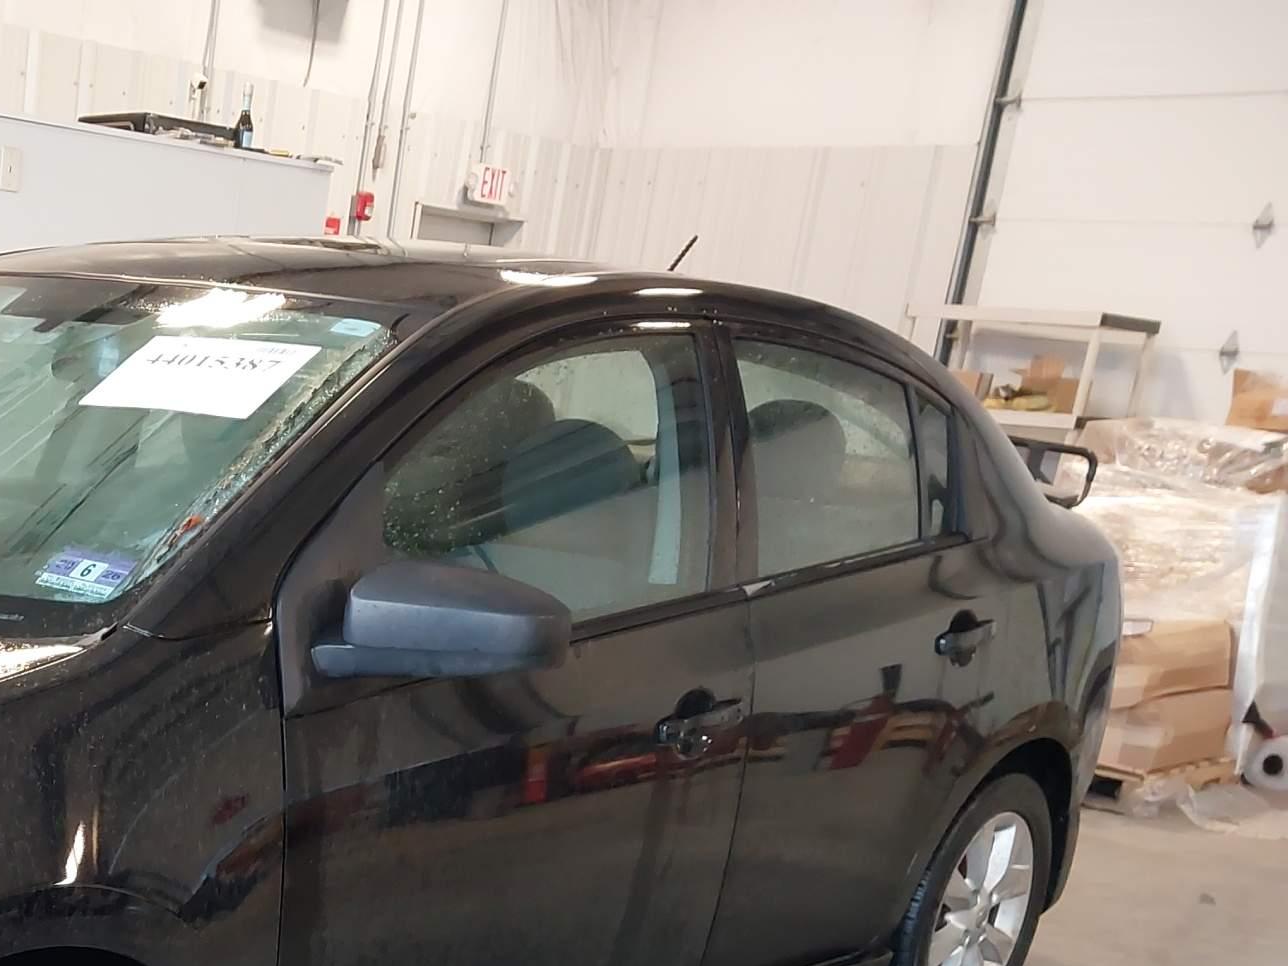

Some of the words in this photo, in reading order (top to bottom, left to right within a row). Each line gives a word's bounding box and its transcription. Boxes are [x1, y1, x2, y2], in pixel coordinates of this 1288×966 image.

[480, 166, 507, 201] EXIT
[146, 353, 282, 372] 44015387
[80, 563, 97, 577] 6
